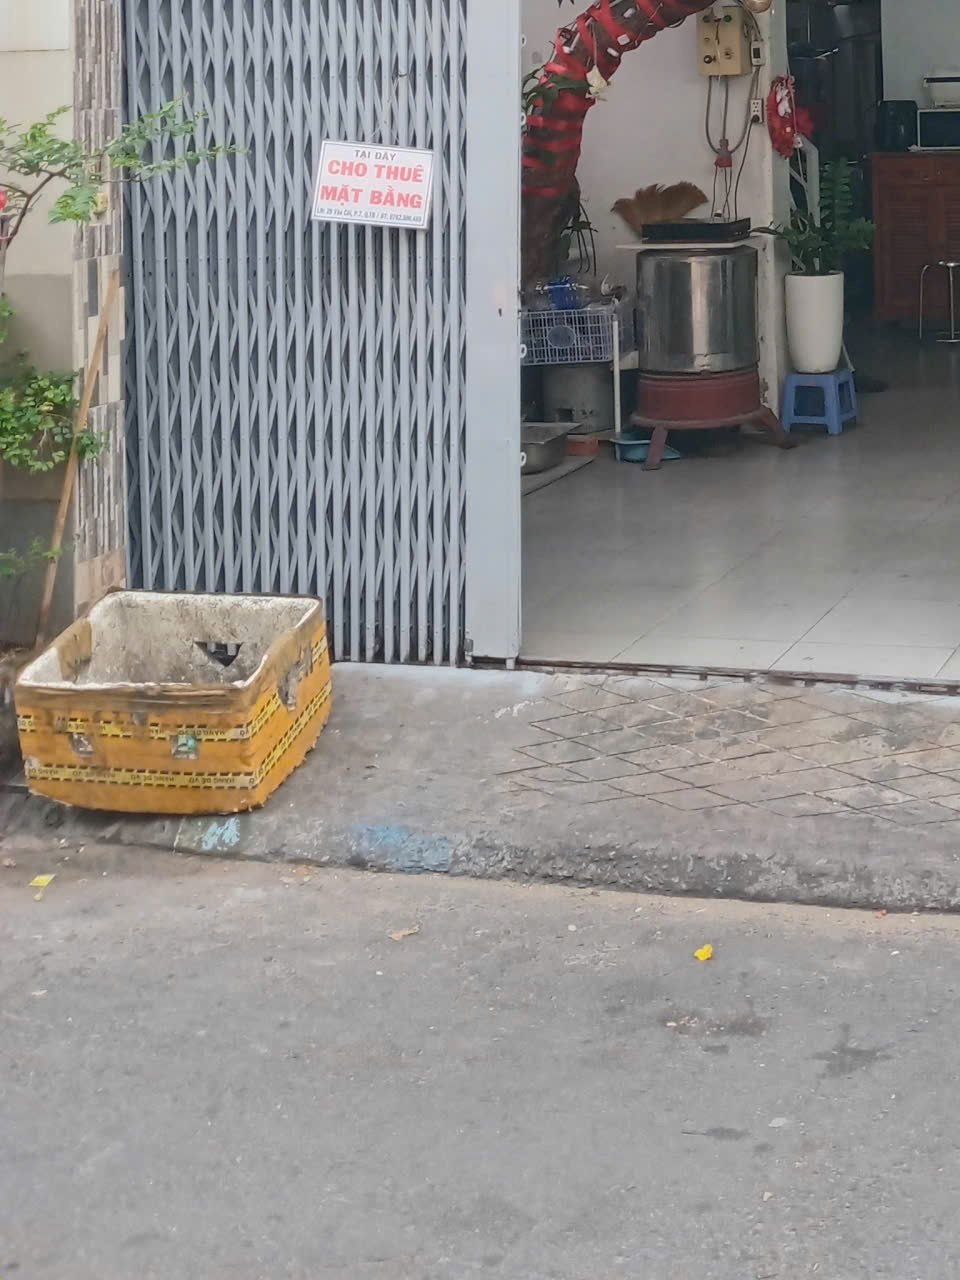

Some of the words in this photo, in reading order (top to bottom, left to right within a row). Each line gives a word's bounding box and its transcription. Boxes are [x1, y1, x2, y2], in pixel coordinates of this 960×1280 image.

[328, 160, 368, 177] CHO
[374, 165, 425, 183] THUÊ
[320, 184, 363, 206] MẶT
[369, 185, 422, 209] BẰNG
